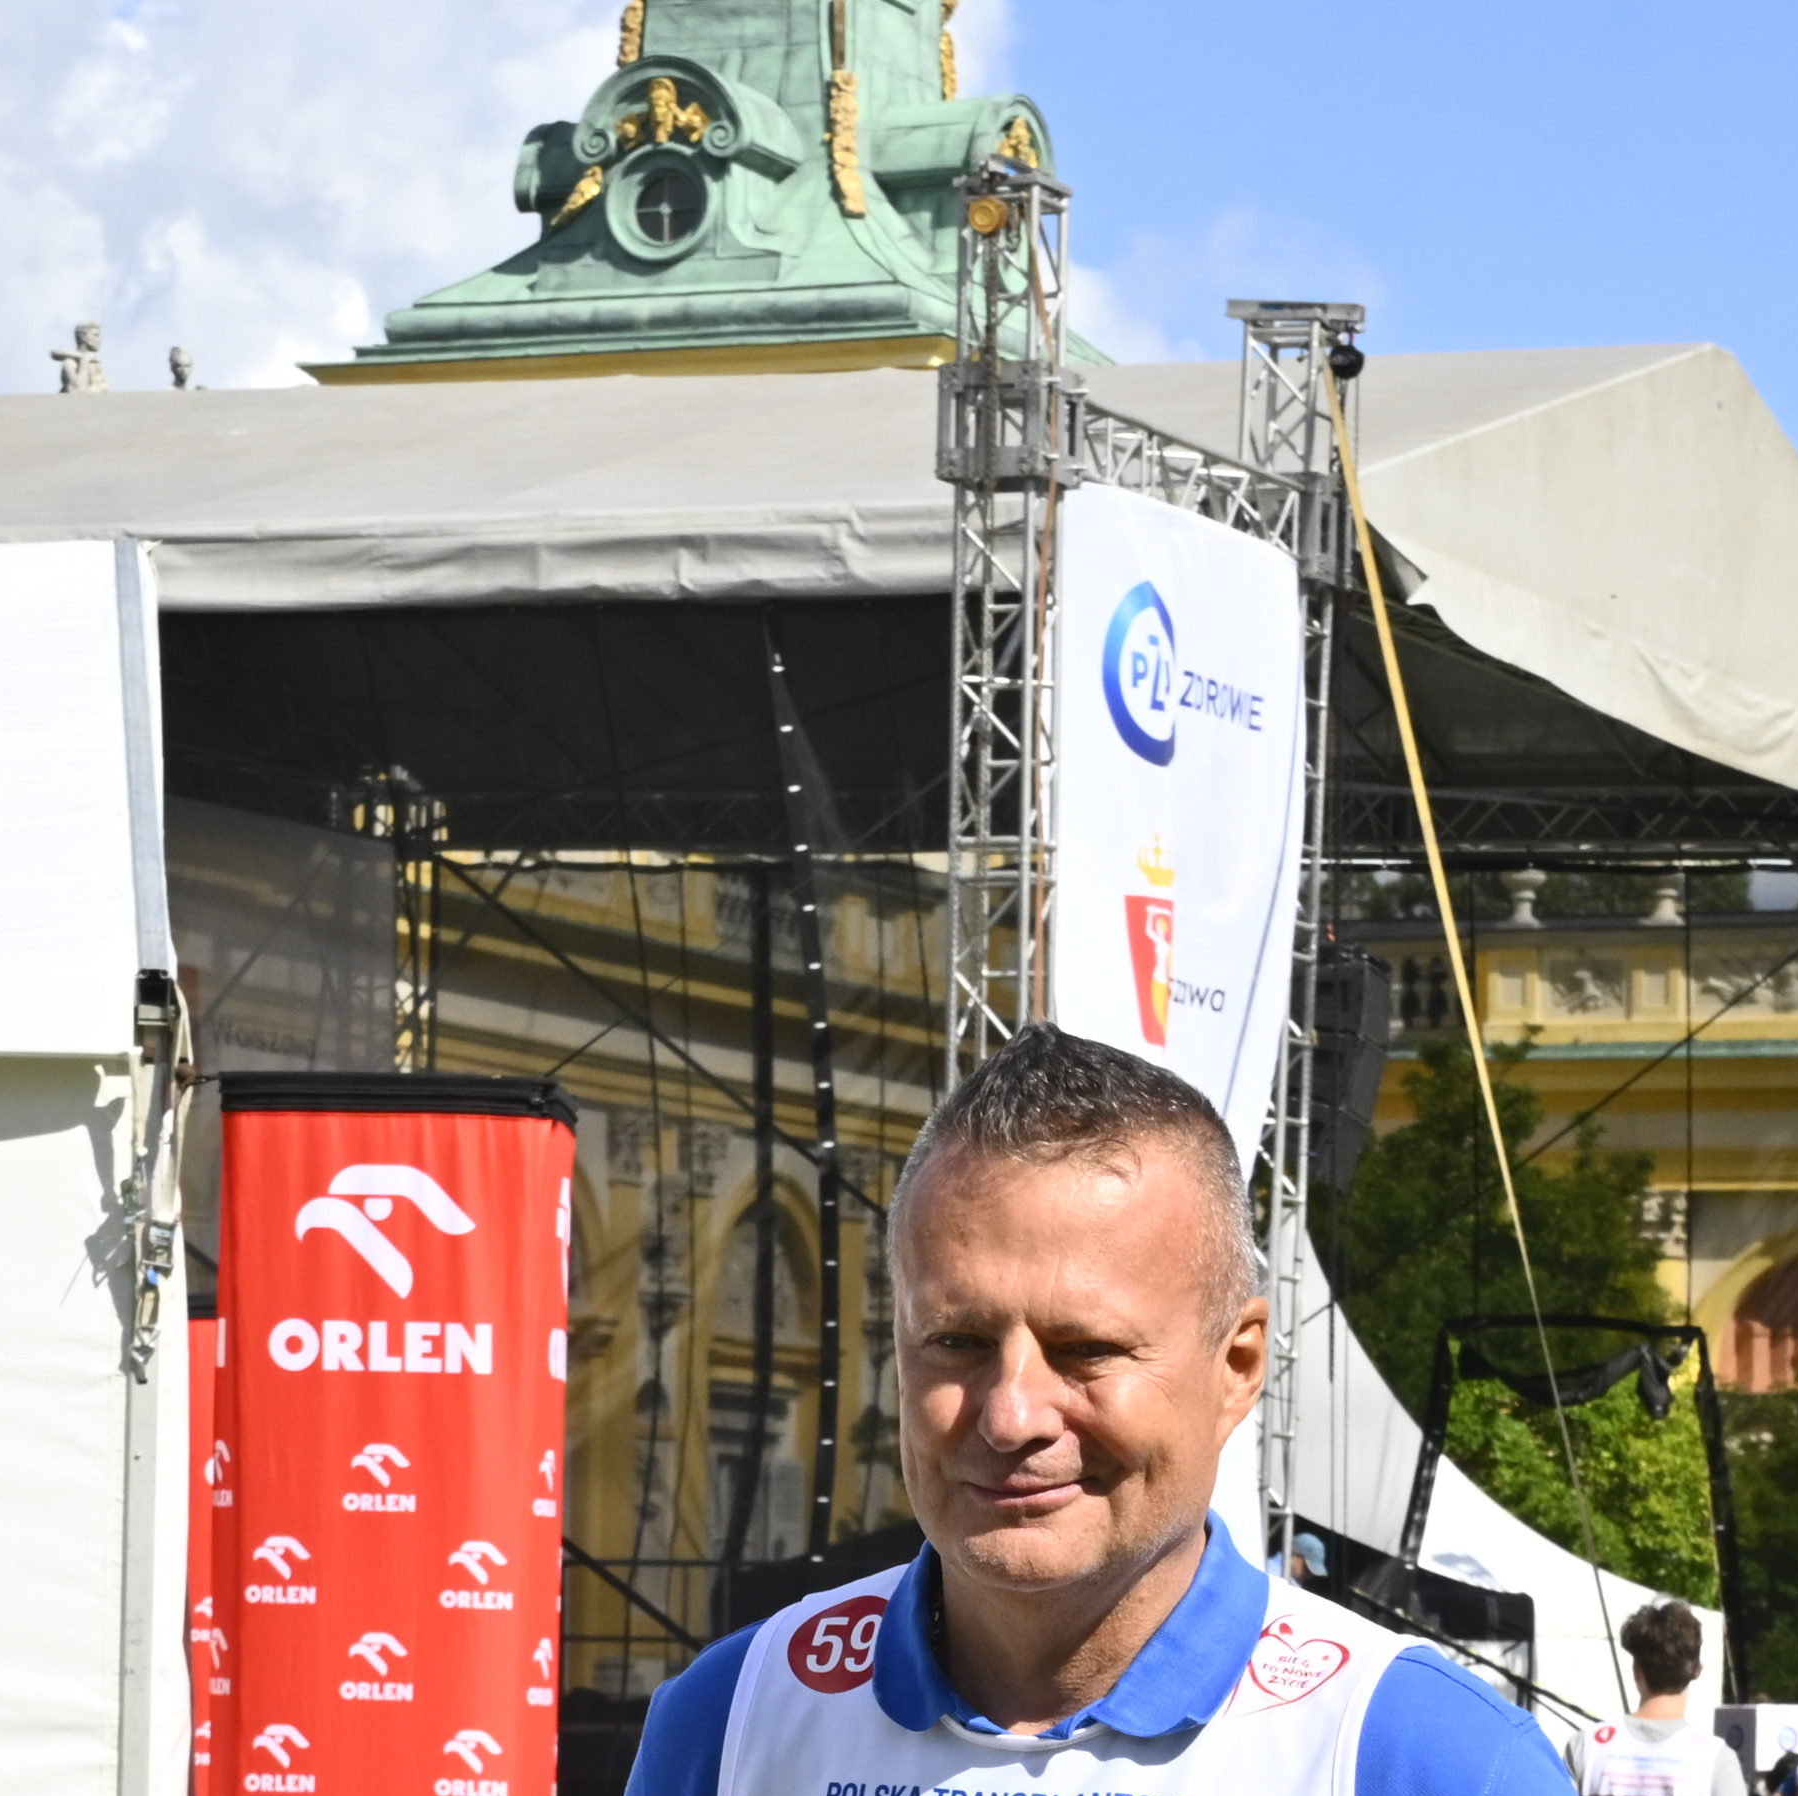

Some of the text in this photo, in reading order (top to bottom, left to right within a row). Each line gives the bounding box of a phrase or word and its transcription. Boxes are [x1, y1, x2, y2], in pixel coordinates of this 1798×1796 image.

[268, 1318, 493, 1375] ORLEN
[342, 1493, 416, 1513] ORLEN
[245, 1585, 316, 1604] ORLEN
[439, 1590, 513, 1610] ORLEN
[806, 1614, 883, 1673] 59
[339, 1682, 414, 1702] ORLEN
[244, 1774, 316, 1793] ORLEN
